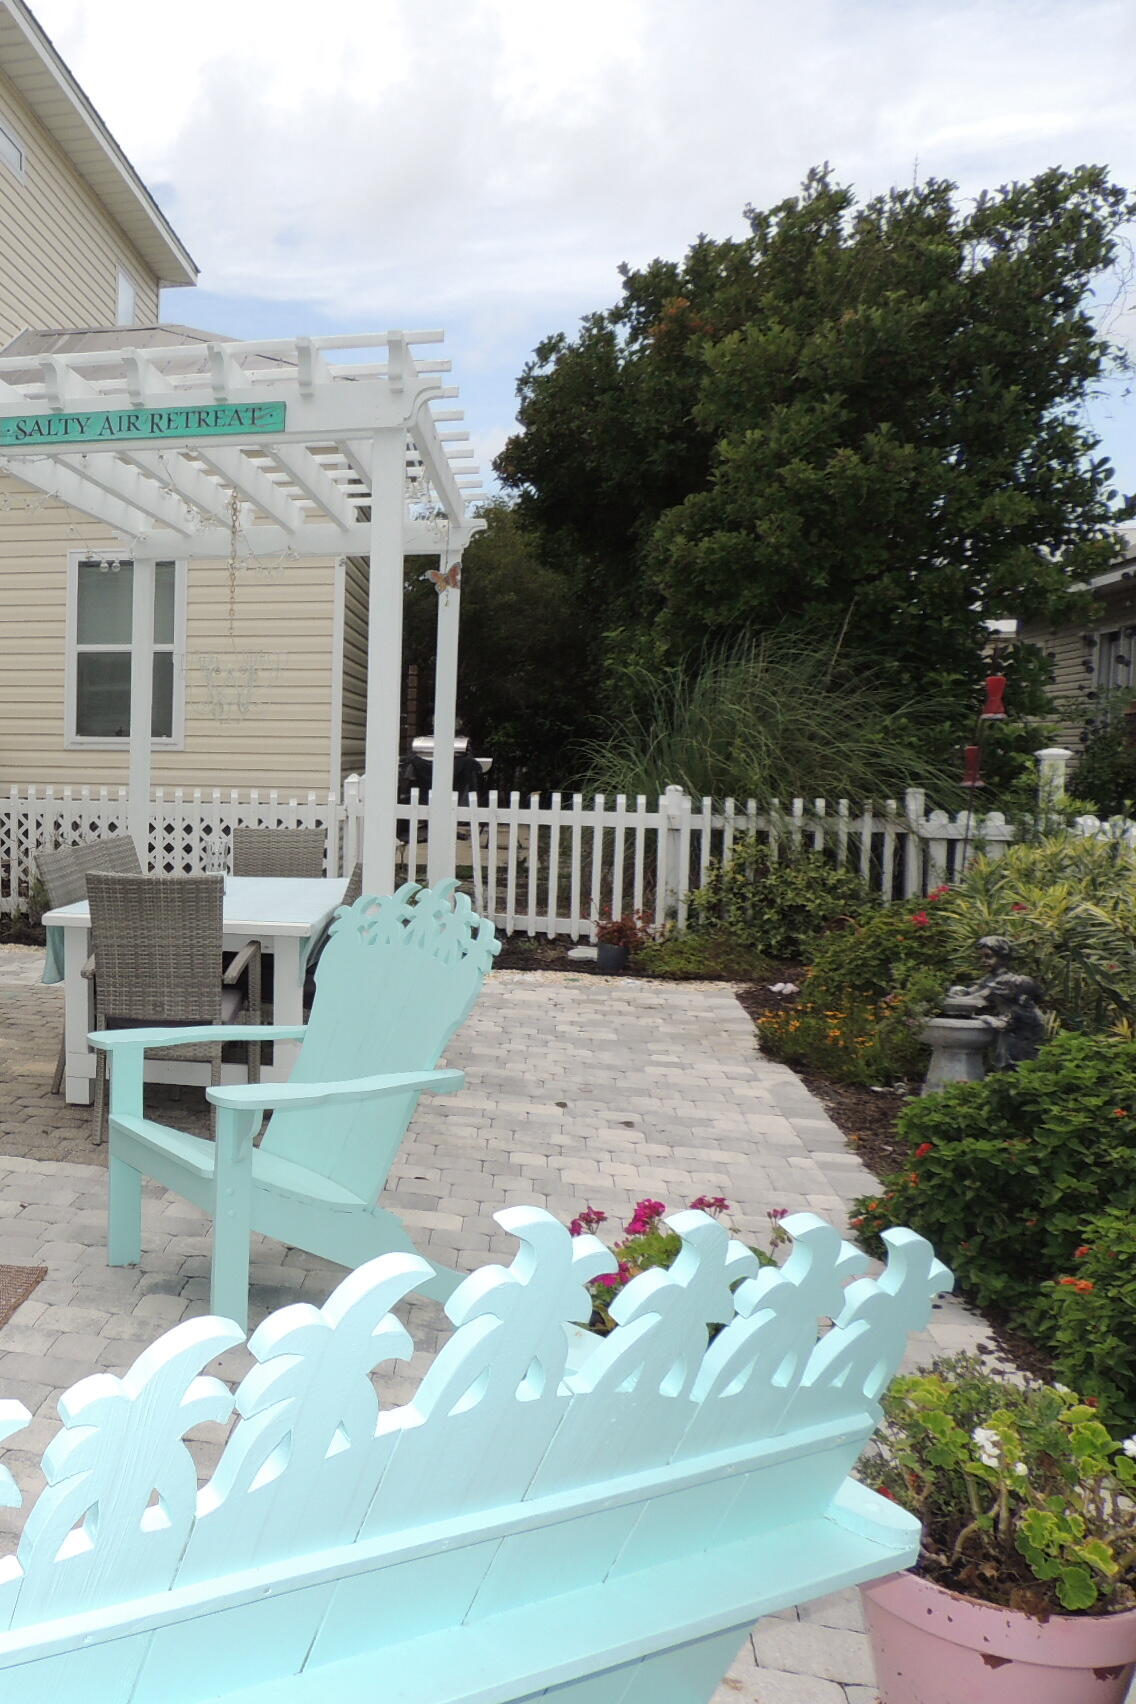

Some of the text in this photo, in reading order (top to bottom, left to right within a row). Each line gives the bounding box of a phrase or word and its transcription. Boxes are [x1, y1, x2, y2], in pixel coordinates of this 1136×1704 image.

[15, 407, 262, 440] SALTY AIR RETREAT
